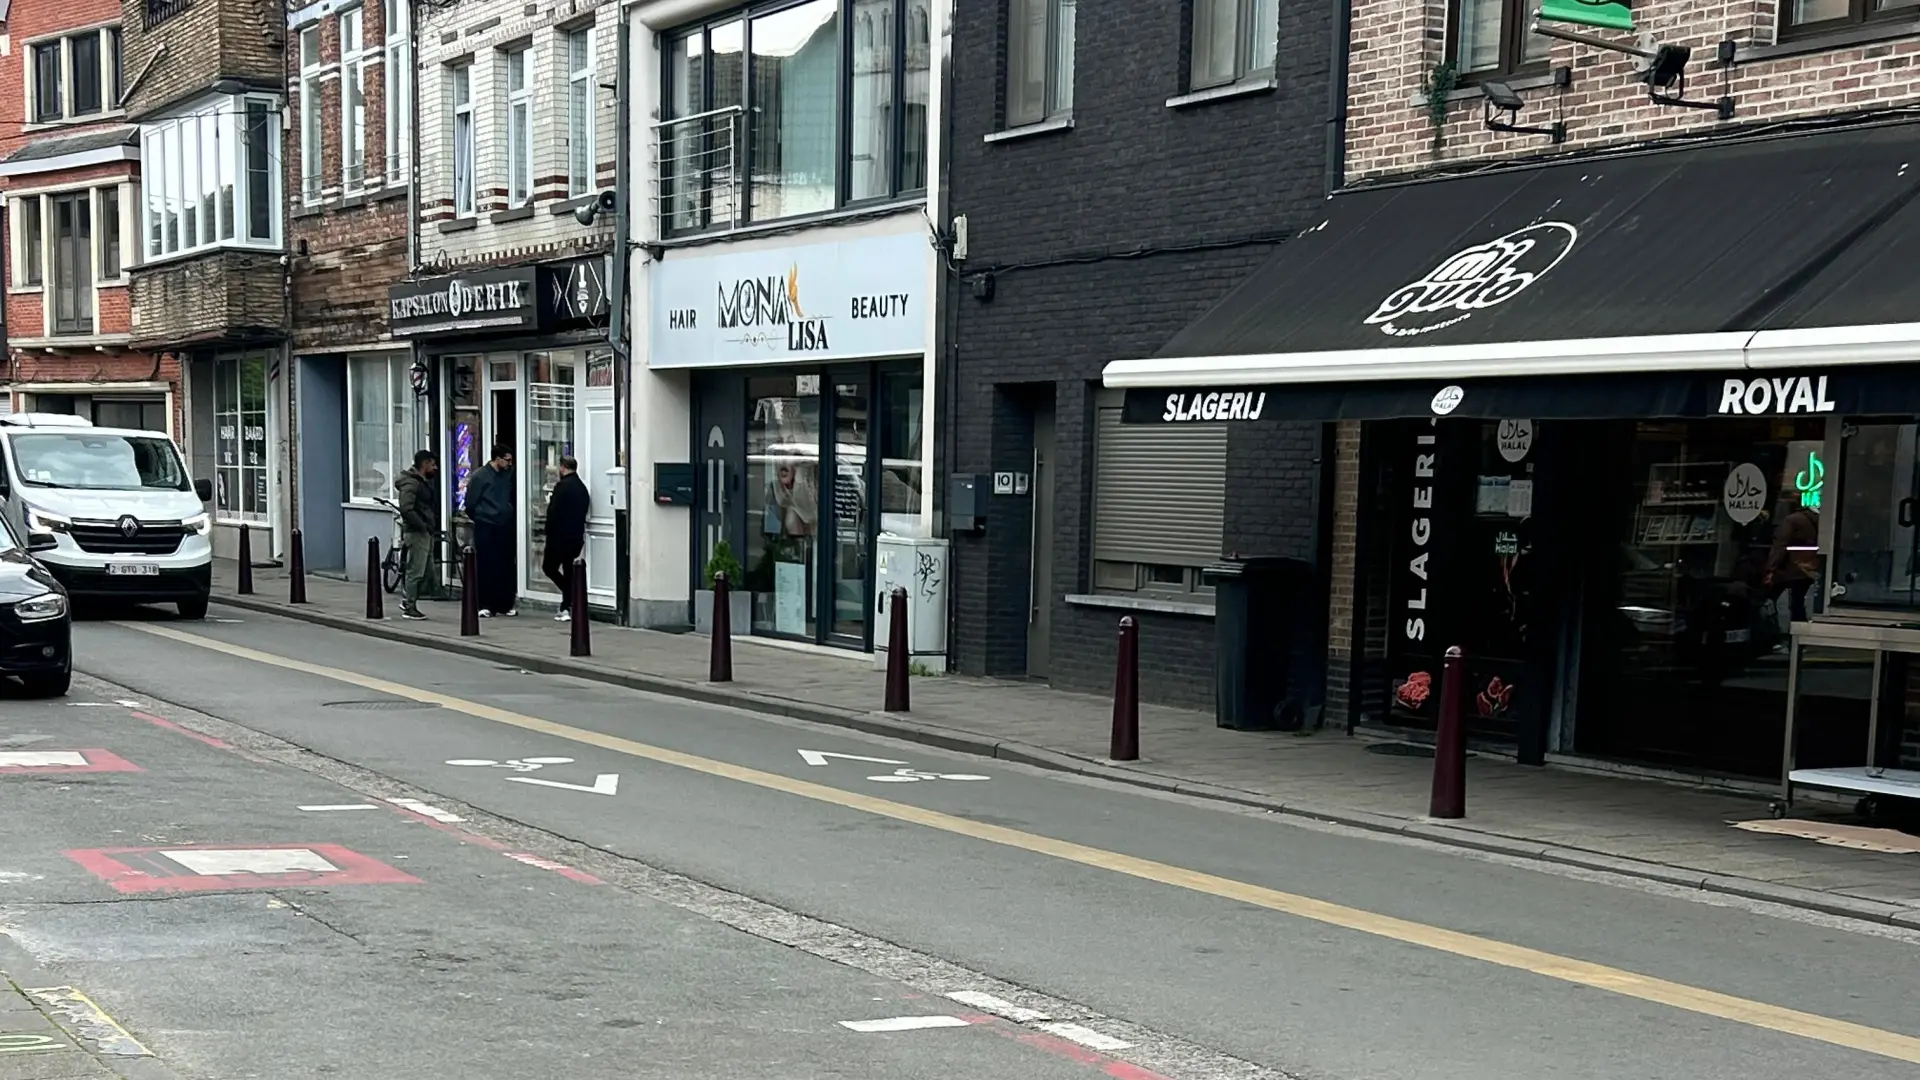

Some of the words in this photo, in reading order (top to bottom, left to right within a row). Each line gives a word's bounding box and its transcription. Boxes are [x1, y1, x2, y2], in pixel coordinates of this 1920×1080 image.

[391, 290, 449, 319] KAPSALON
[462, 280, 521, 312] DERIK
[718, 274, 793, 328] MONA
[851, 293, 909, 319] BEAUTY
[669, 309, 697, 329] HAIR
[787, 319, 829, 351] LISA
[1162, 391, 1266, 422] SLAGERIJ
[1718, 375, 1836, 415] ROYAL
[1501, 441, 1527, 451] HALAL
[997, 474, 1010, 486] 10
[1728, 500, 1760, 510] HALAL
[1406, 417, 1438, 642] SLAGERI
